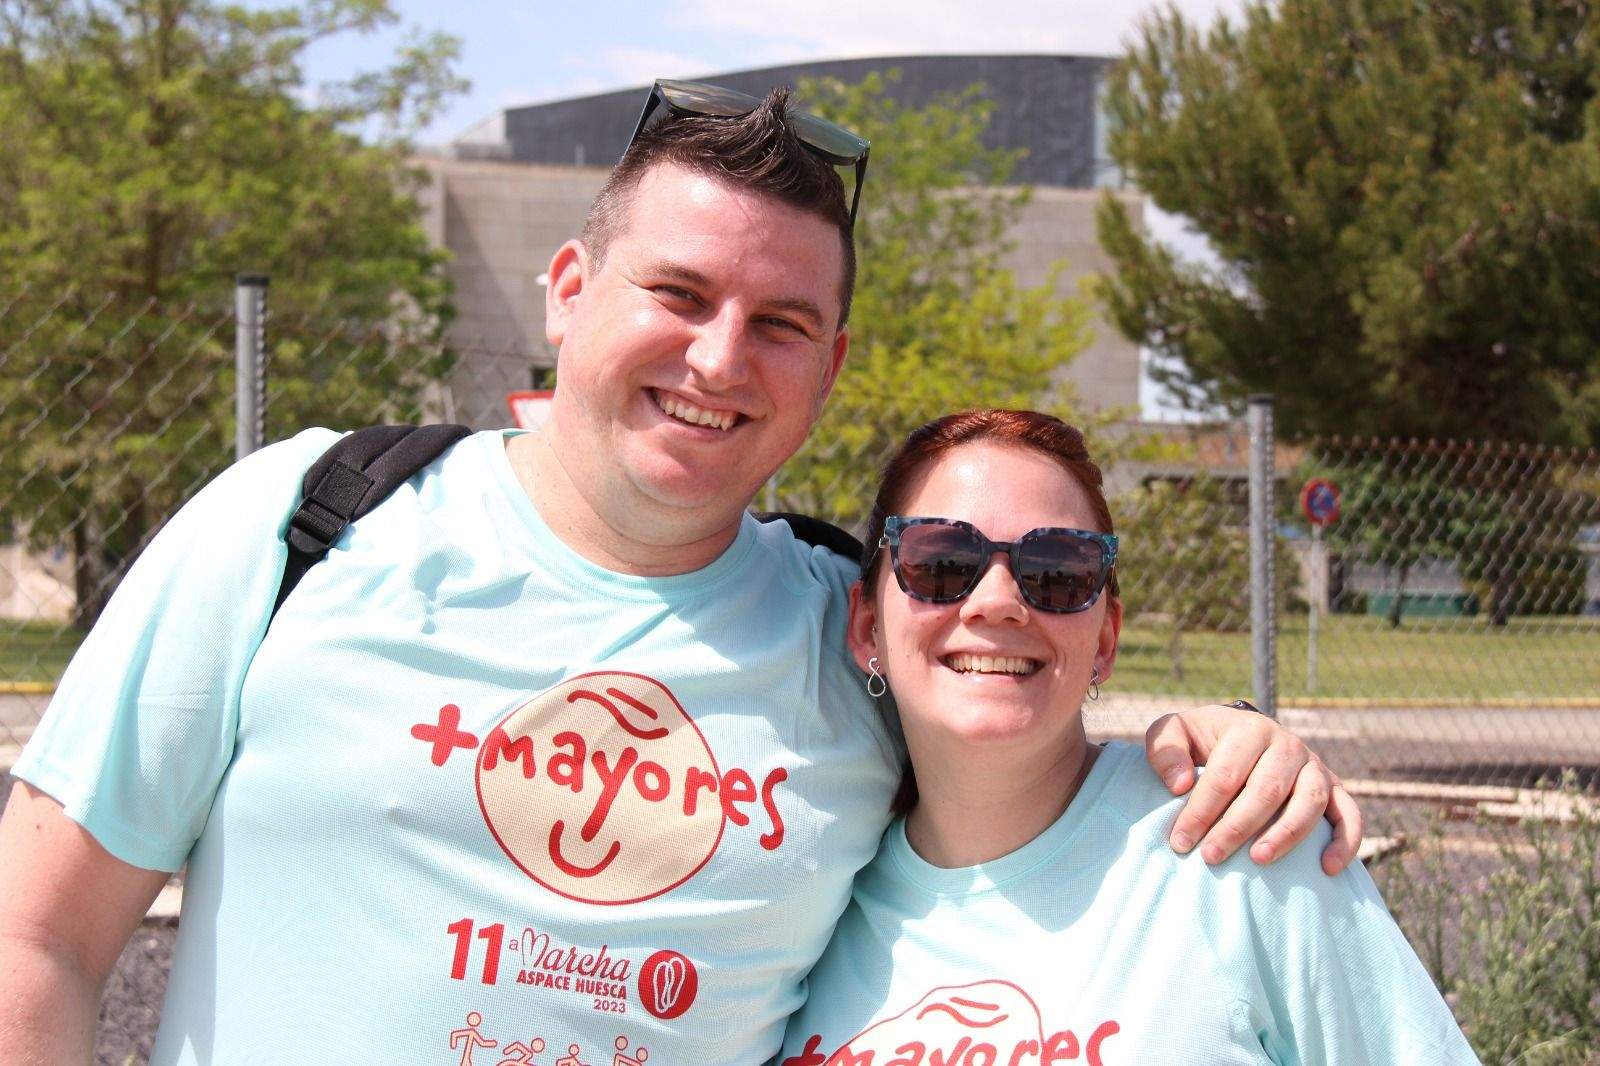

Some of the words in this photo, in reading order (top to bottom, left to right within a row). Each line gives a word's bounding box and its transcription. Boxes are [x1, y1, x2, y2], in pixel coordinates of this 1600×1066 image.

[521, 927, 632, 982] Marcha
[516, 969, 570, 991] ASPACE
[575, 976, 627, 999] HUESCA
[593, 998, 626, 1013] 2023
